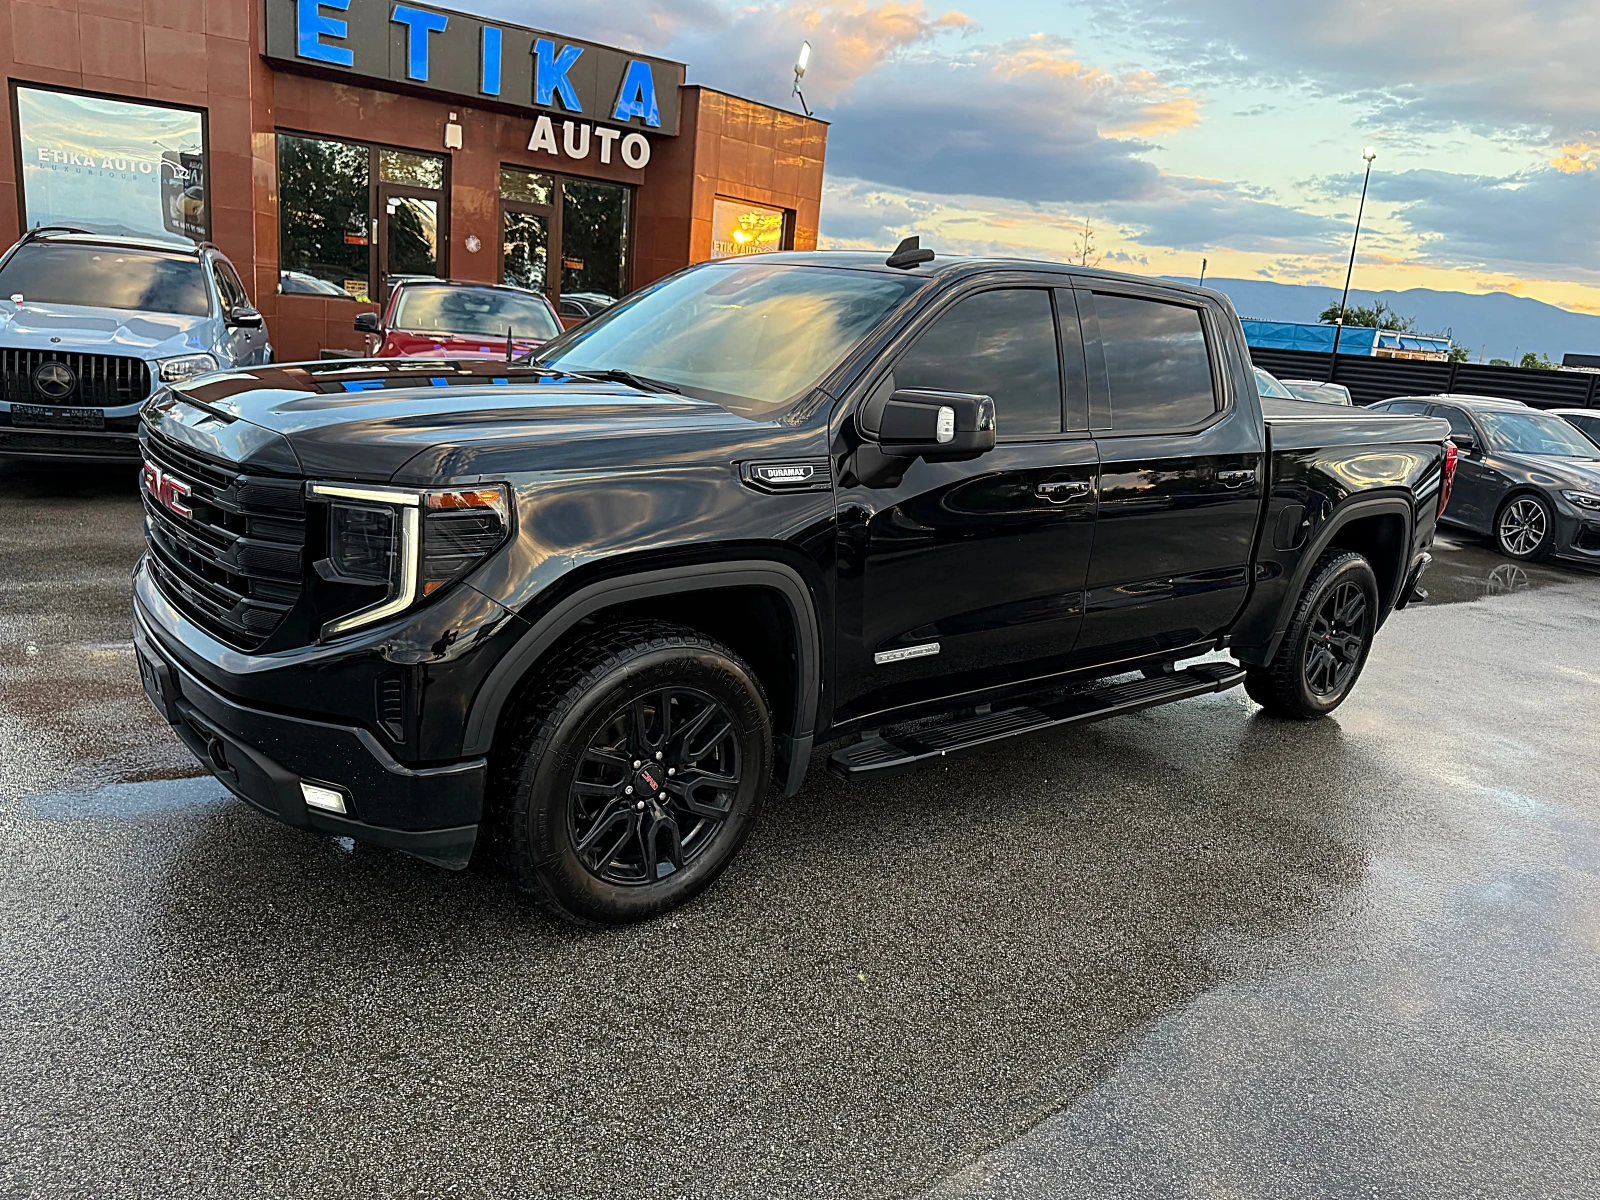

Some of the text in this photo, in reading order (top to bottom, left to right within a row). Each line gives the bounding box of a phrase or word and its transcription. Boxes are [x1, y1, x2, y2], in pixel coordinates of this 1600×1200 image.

[297, 0, 661, 128] ETIKA
[528, 115, 651, 170] AUTO
[37, 147, 153, 174] ETIKA AUTO
[40, 163, 138, 181] LUXURIOUS
[713, 240, 739, 255] ETIKA
[767, 467, 805, 478] DURAMAX
[143, 459, 193, 520] GMC
[641, 770, 659, 791] GMC
